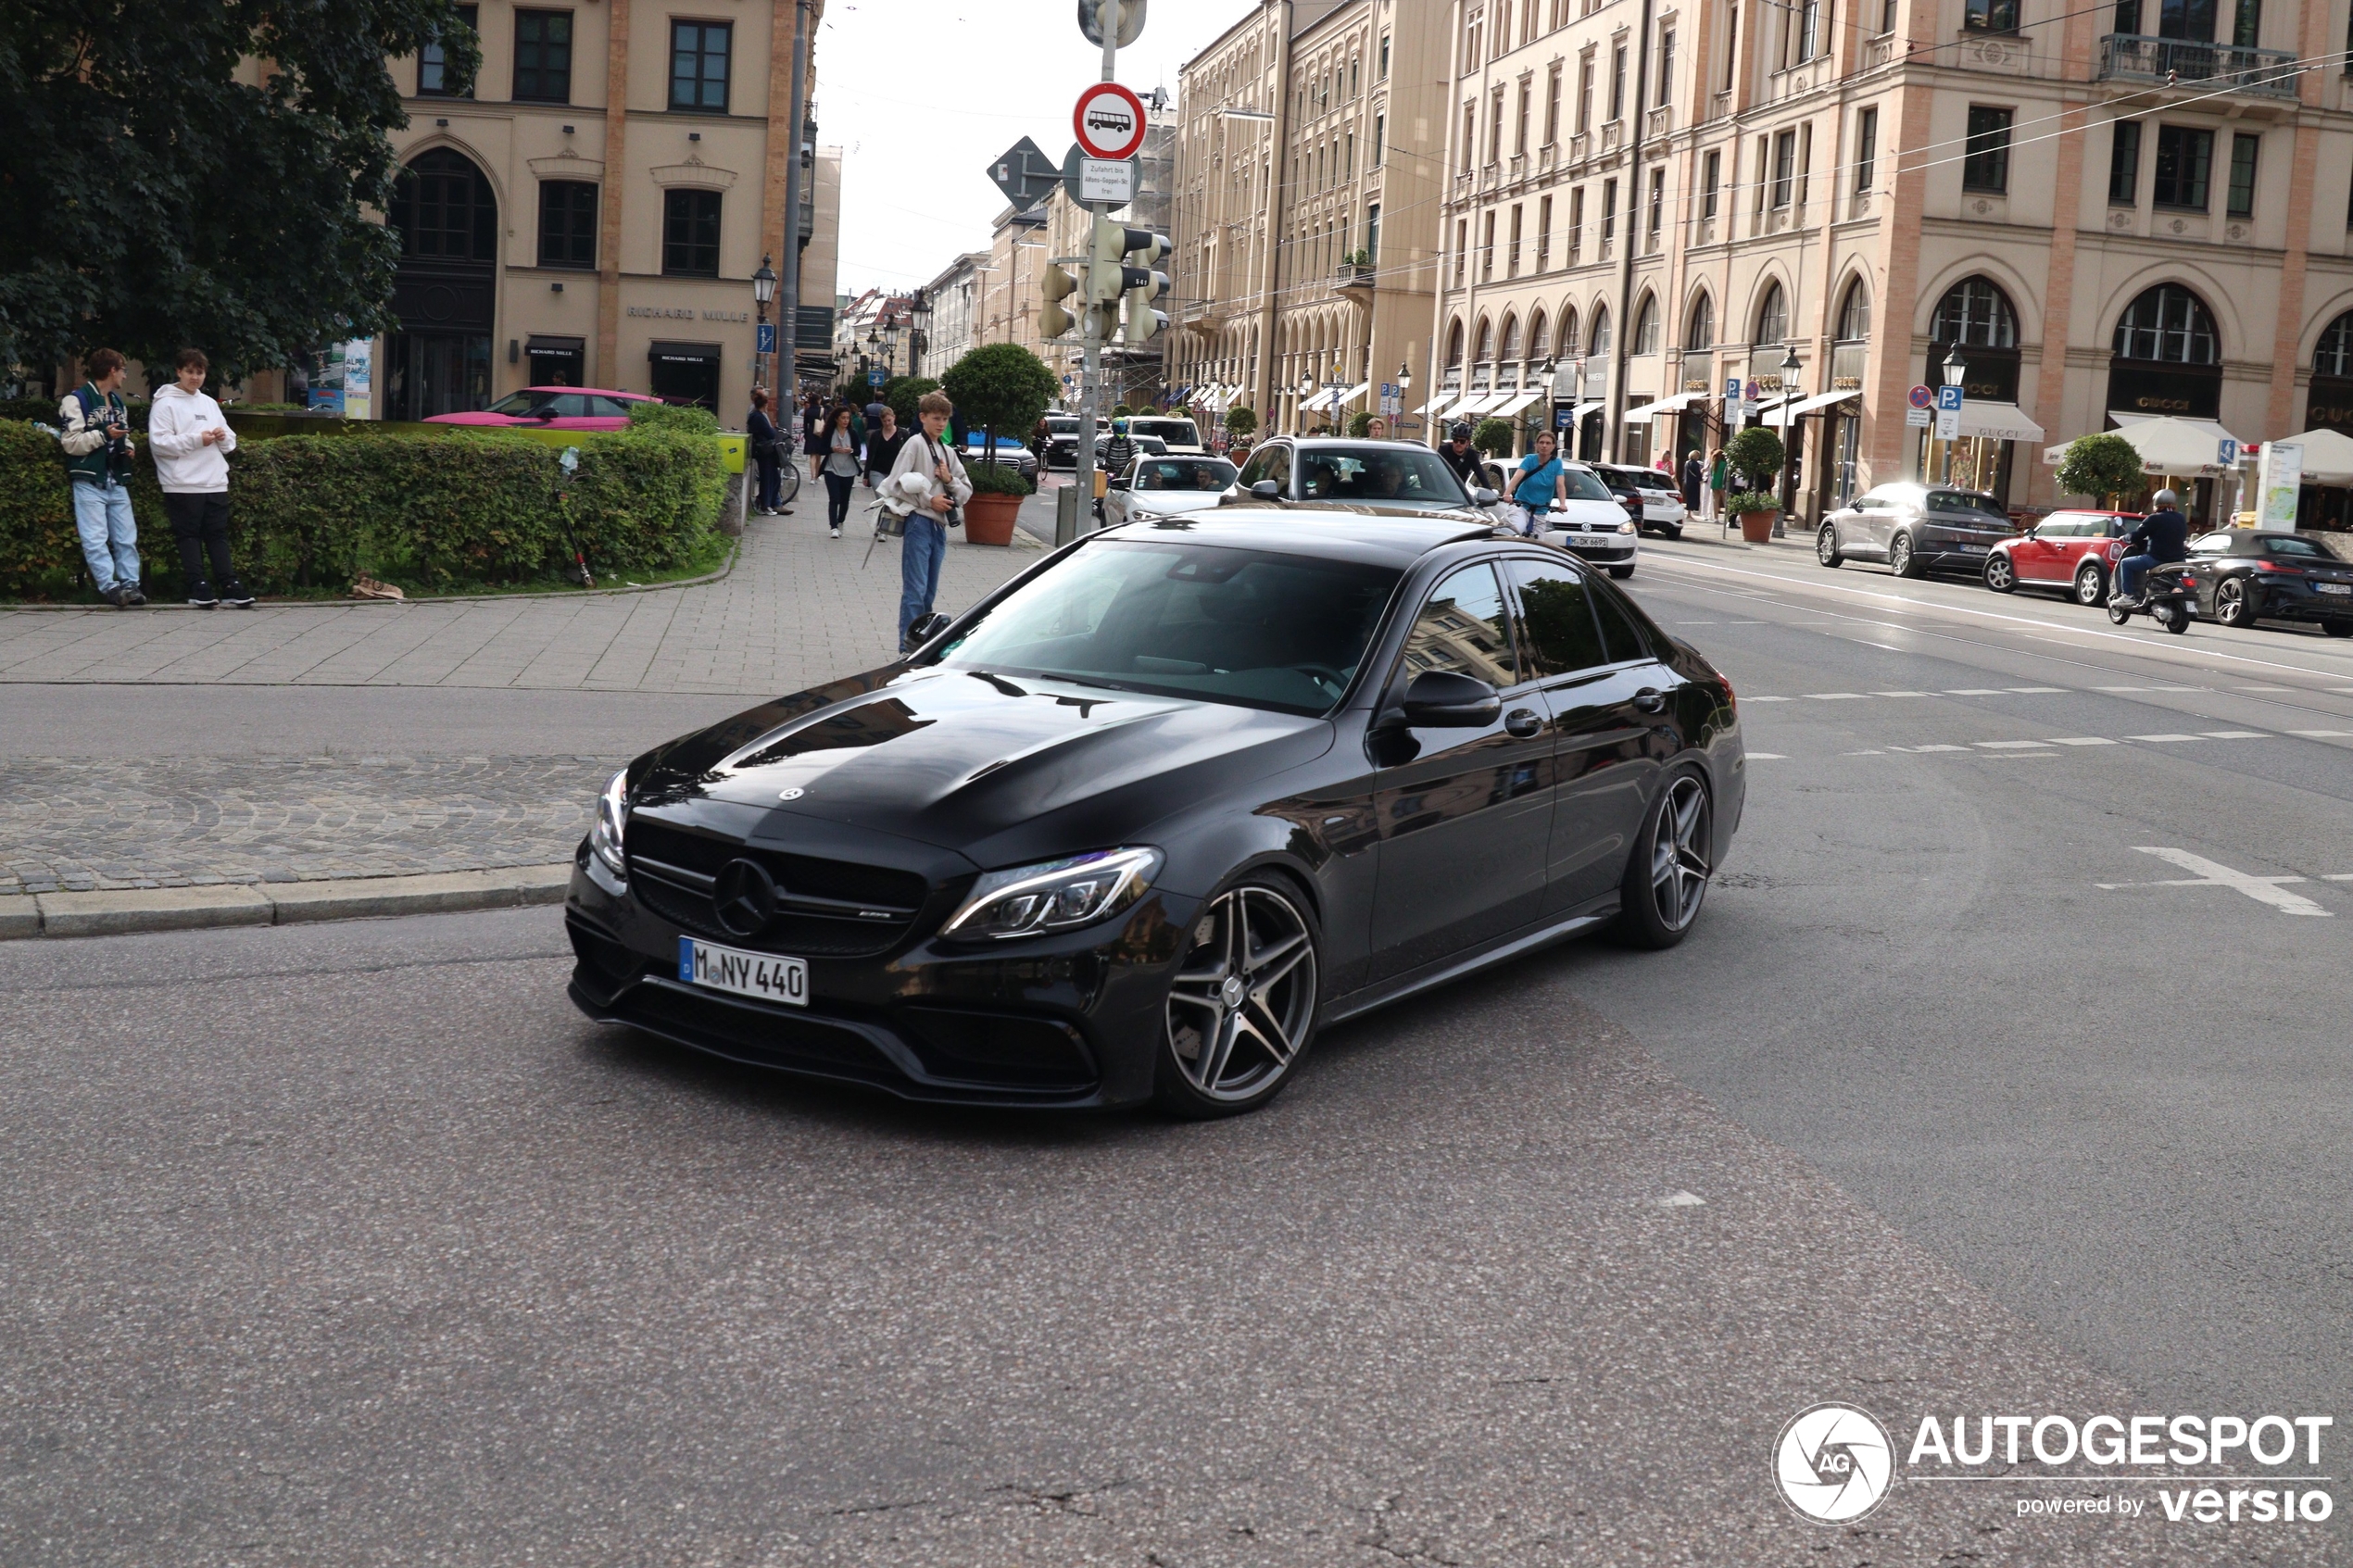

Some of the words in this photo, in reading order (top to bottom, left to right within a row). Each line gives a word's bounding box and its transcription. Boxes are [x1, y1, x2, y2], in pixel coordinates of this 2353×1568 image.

[1090, 165, 1114, 173] Zufahrt
[1135, 278, 1148, 286] 541
[627, 306, 695, 320] RICHARD
[702, 310, 749, 322] MILLE
[1729, 381, 1737, 396] P
[1942, 389, 1956, 407] P
[2138, 396, 2189, 410] GUCCI
[1979, 428, 2019, 438] GUCCI
[695, 947, 707, 980] M
[721, 953, 749, 989] NY
[756, 960, 802, 997] 440
